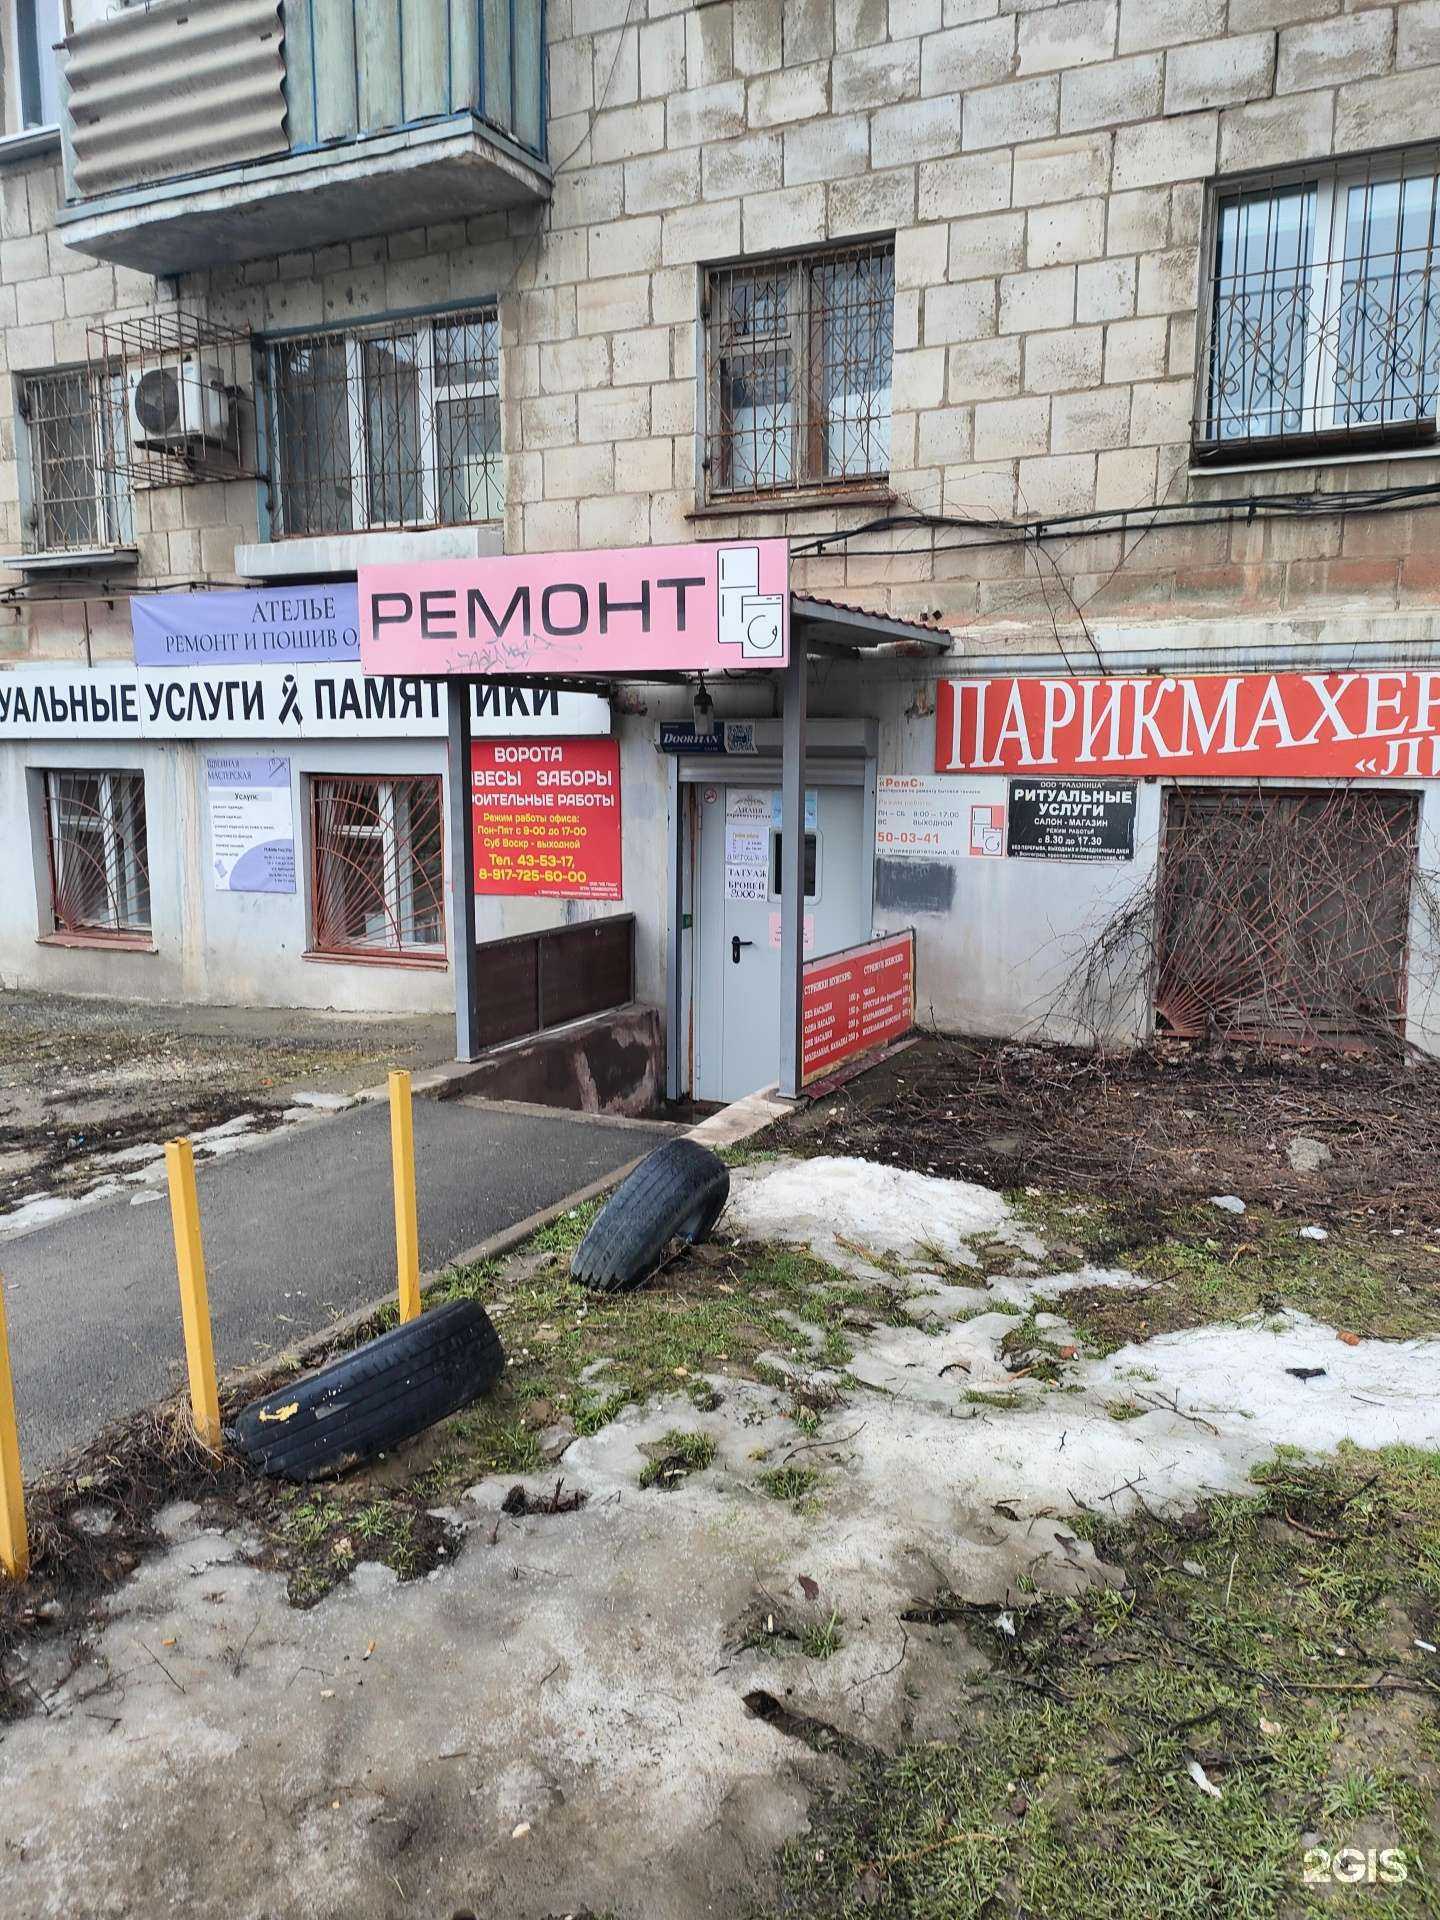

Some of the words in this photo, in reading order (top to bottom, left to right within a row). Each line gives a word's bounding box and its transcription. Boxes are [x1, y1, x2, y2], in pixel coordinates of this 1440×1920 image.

[252, 597, 336, 624] АТЕЛЬЕ
[371, 576, 706, 641] РЕМОНТ
[165, 633, 239, 653] РЕМОНТ
[244, 633, 256, 651] И
[263, 628, 337, 651] ПОШИВ
[343, 627, 360, 651] О
[145, 680, 265, 722] УСЛУГИ
[314, 678, 560, 720] ПАМЯТИКИ
[945, 671, 1440, 770] ПАРИКМАХЕР
[494, 746, 563, 763] ВОРОТА
[471, 770, 522, 786] ВЕСЫ
[536, 770, 612, 786] ЗАБОРЫ
[558, 794, 615, 807] РАБОТЫ
[1014, 788, 1132, 804] РИТУАЛЬНЫЕ
[1039, 803, 1104, 817] УСЛУГИ
[483, 812, 512, 823] Режим
[515, 813, 547, 824] работы
[1034, 818, 1063, 826] САЛОН
[1069, 818, 1108, 827] МАГАЗИН
[562, 826, 587, 836] 17-00
[877, 832, 939, 844] 50-03-41
[484, 838, 500, 849] Суб
[503, 838, 529, 849] Воскр
[537, 838, 580, 849] выходной
[1044, 835, 1063, 844] 8.30
[1078, 836, 1102, 846] 17.30
[489, 854, 513, 866] Тел.
[517, 854, 575, 869] 43-53-17,
[729, 868, 767, 878] ТАТУАЖ
[728, 881, 765, 890] БРОВЕЙ
